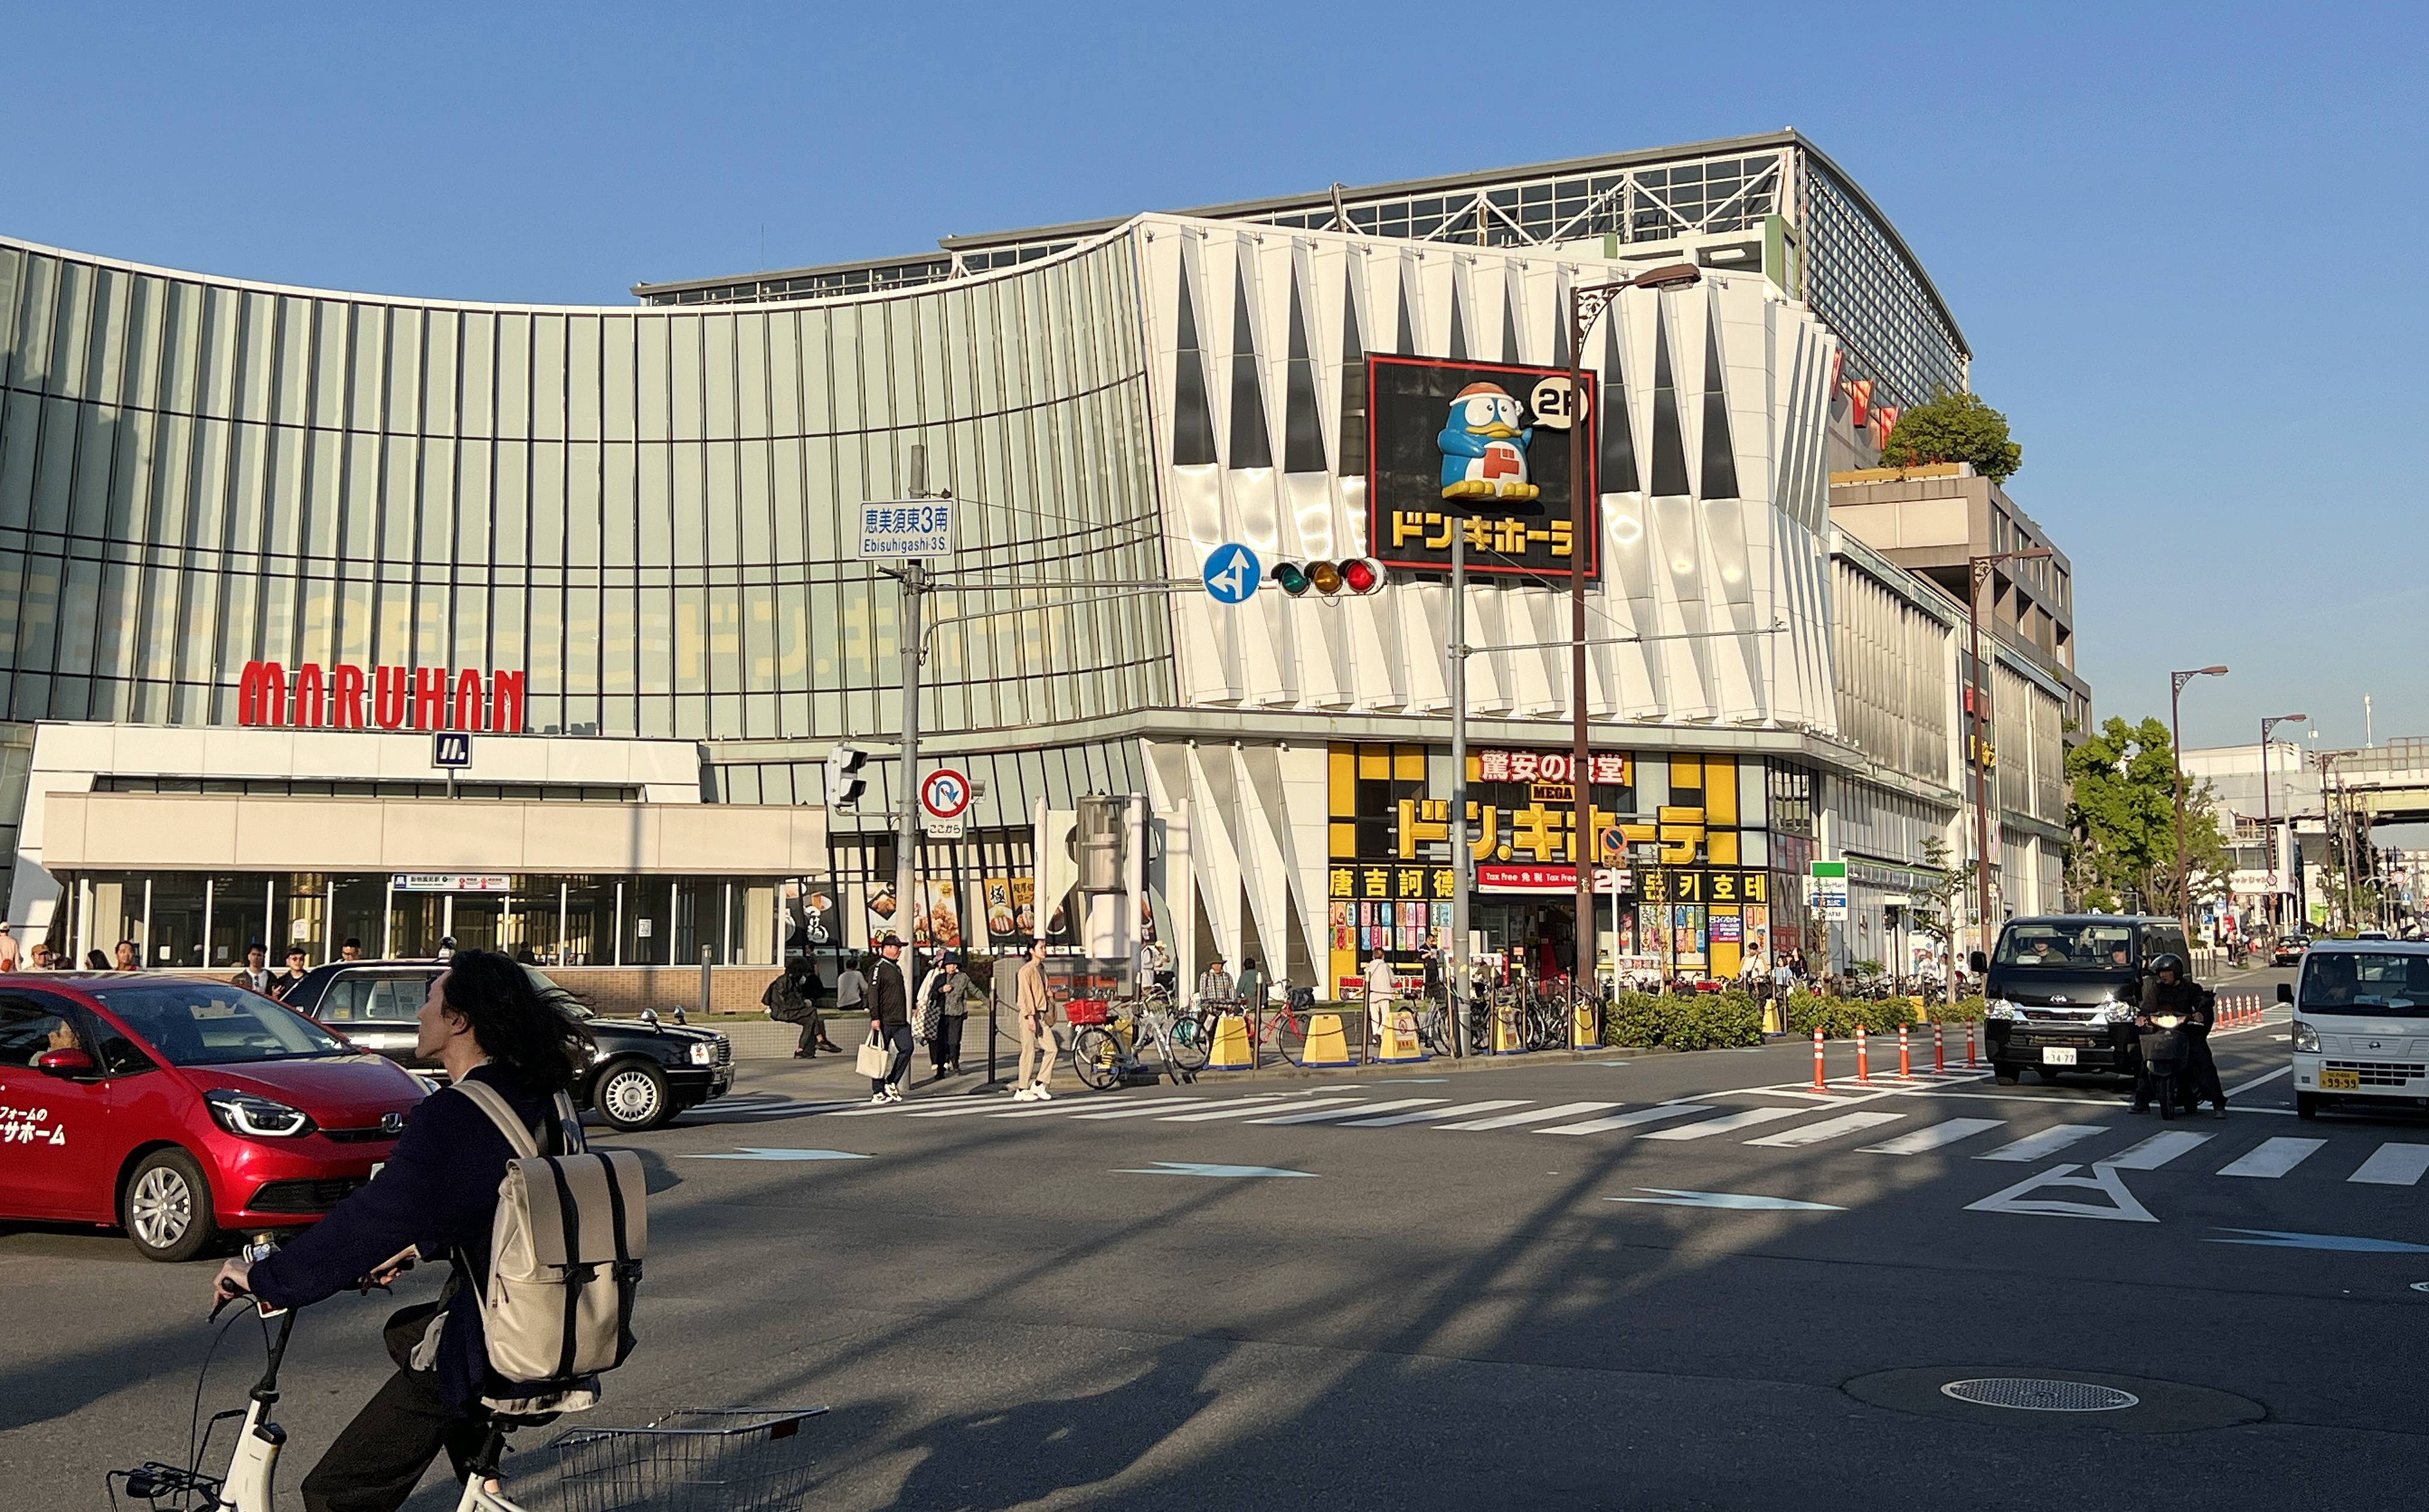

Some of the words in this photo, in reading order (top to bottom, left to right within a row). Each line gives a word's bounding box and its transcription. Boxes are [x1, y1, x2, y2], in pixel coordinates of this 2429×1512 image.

[864, 506, 948, 534] 恵美須東3南
[239, 660, 525, 733] MARUHAN
[1533, 787, 1573, 799] MEGA
[930, 824, 961, 834] ここから
[1594, 869, 1631, 893] 2F
[0, 1106, 48, 1122] フォームの
[0, 1121, 66, 1145] サホーム
